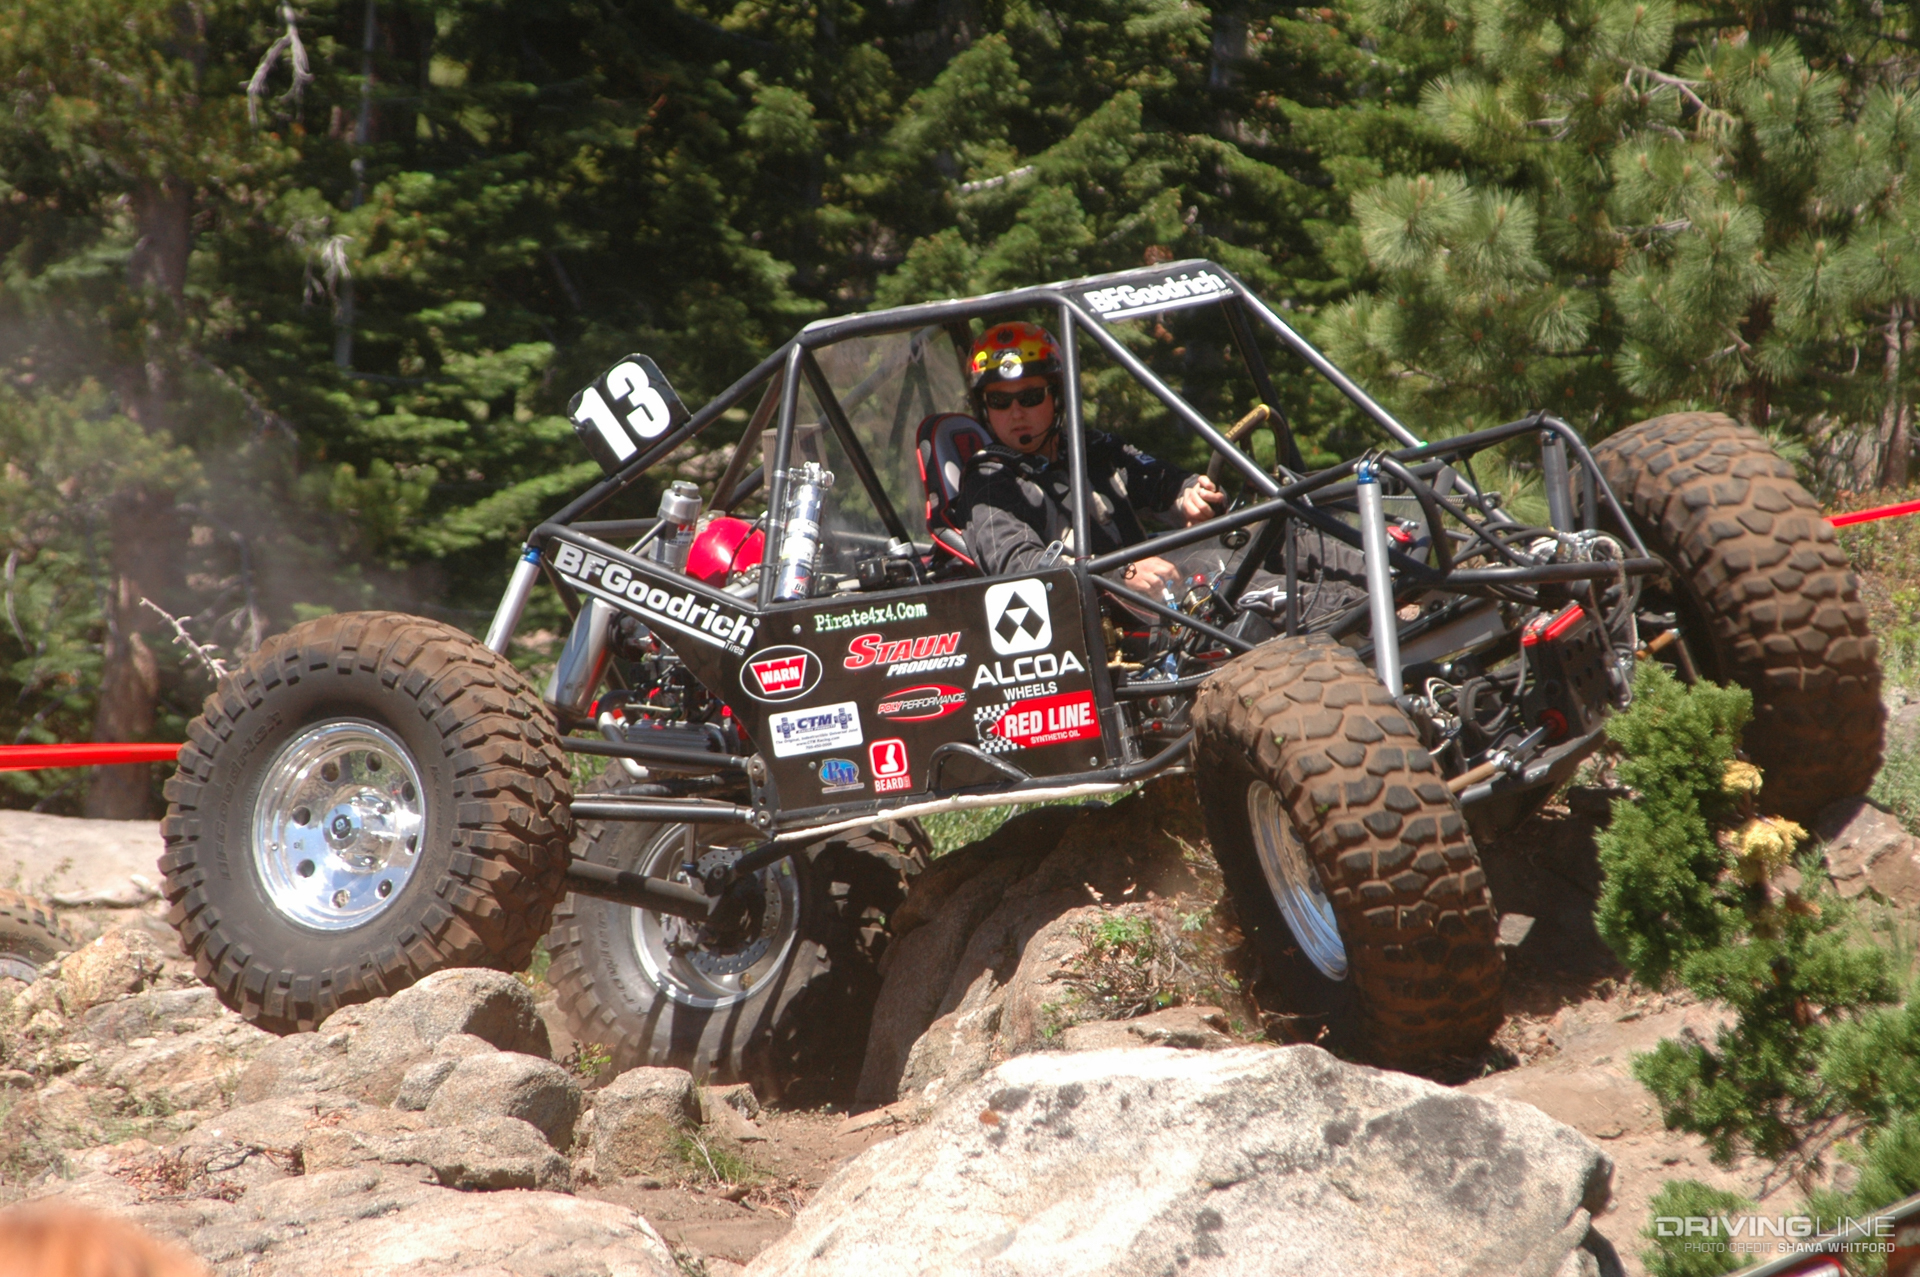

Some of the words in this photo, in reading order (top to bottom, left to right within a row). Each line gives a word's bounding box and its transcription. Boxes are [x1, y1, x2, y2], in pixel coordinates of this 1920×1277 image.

[1083, 270, 1227, 312] BFGoodrich
[574, 361, 671, 461] 13
[554, 542, 754, 647] BFGoodrich
[814, 602, 928, 632] Pirate4x4.Com
[725, 640, 745, 656] Tires
[843, 631, 961, 669] STAUN
[760, 666, 800, 685] WARN
[886, 654, 967, 677] PRODUCTS
[972, 650, 1085, 689] ALCOA
[1003, 681, 1058, 701] WHEELS
[797, 713, 833, 729] CTM
[1004, 710, 1043, 738] RED
[1030, 731, 1068, 744] SYNTHETIC
[1068, 730, 1081, 738] OIL
[874, 777, 904, 792] BEARD
